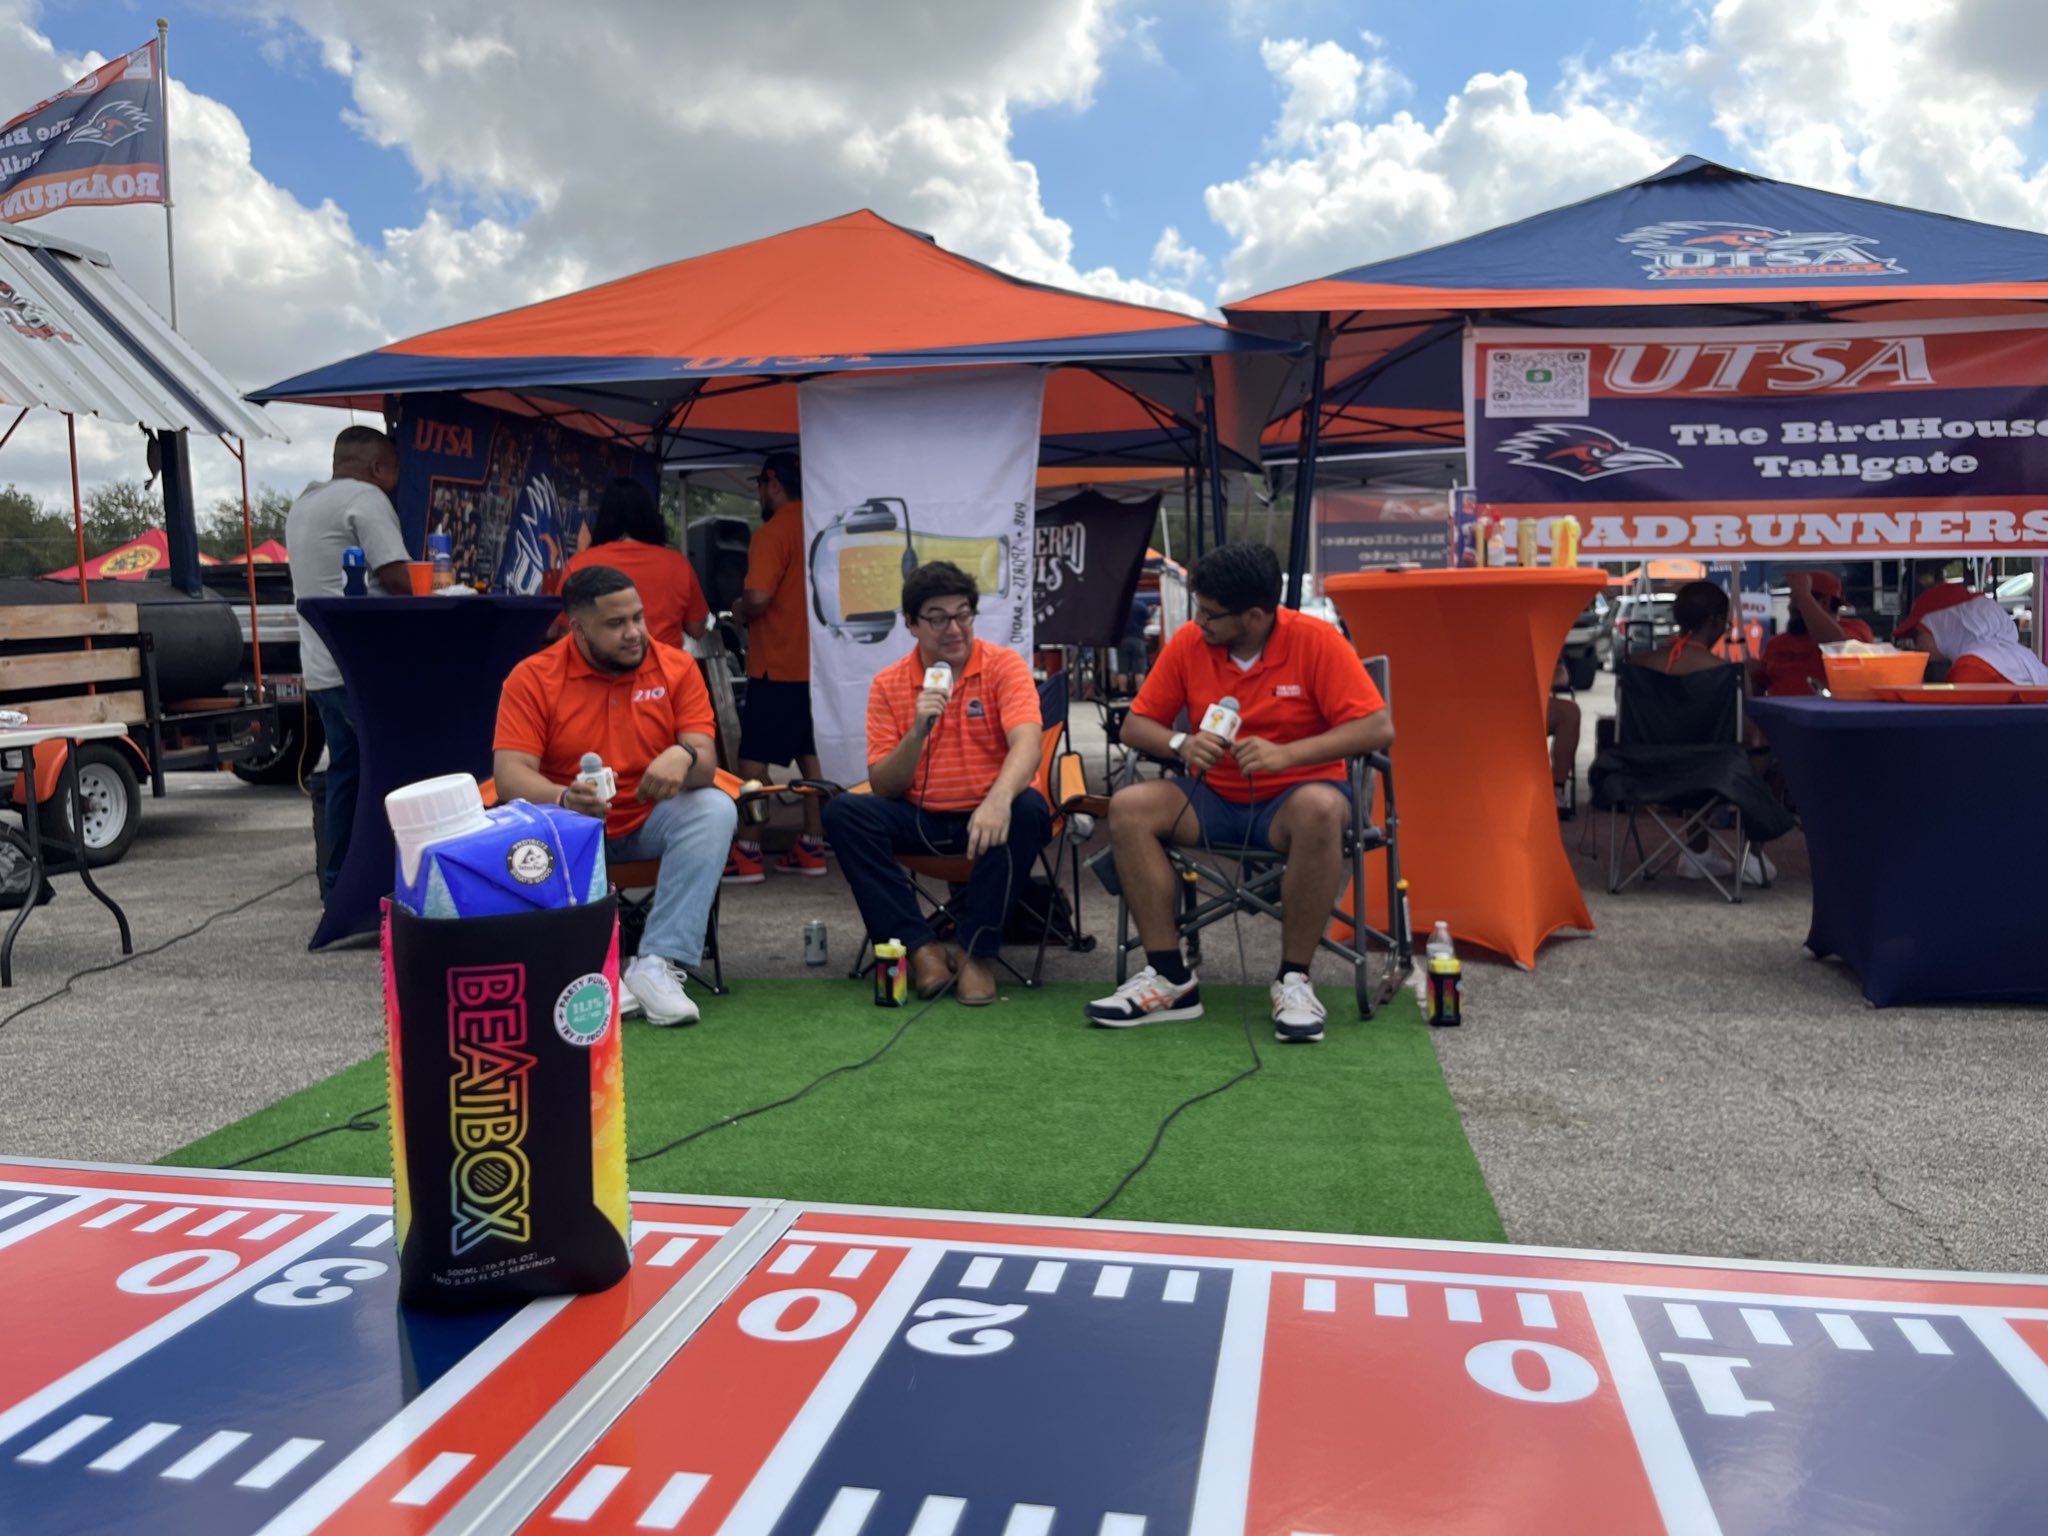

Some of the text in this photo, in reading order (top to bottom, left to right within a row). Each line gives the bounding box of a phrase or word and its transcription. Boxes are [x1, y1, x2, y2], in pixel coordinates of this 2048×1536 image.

[1654, 247, 1870, 269] UTSA
[1604, 337, 1936, 393] UTSA
[415, 418, 473, 459] UTSA
[1670, 424, 1768, 446] The
[1754, 450, 1979, 482] Tailgate
[559, 980, 584, 1008] PARTY
[447, 963, 538, 1256] BEATBOX
[447, 1266, 479, 1277] 500ML
[491, 1268, 506, 1279] OZ
[508, 1255, 556, 1274] SERVINGS
